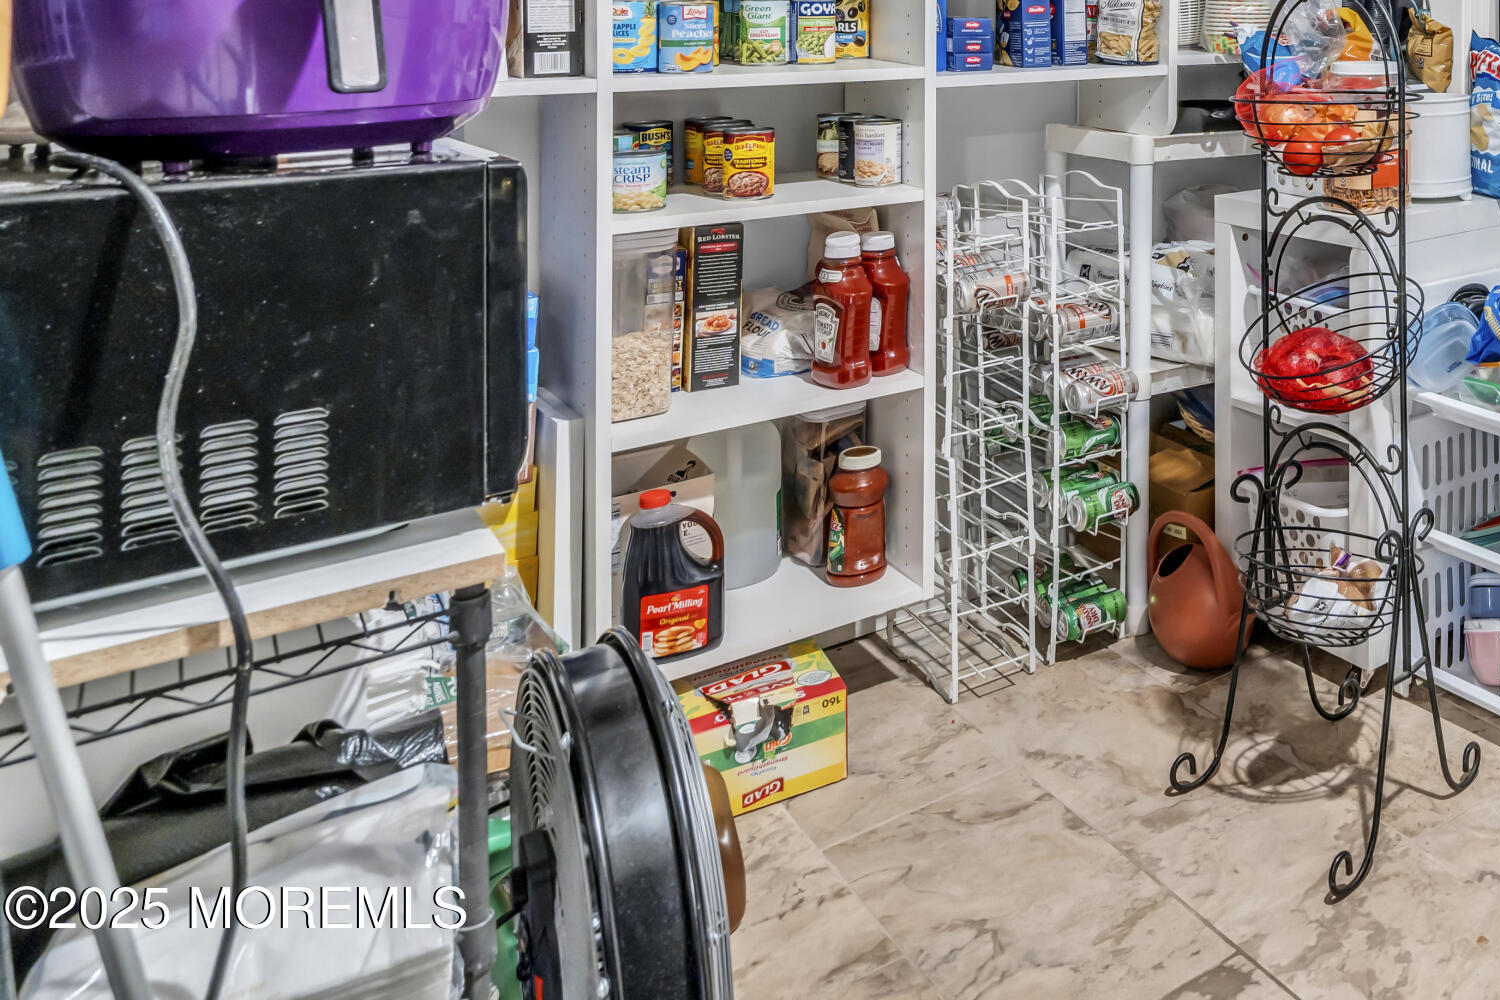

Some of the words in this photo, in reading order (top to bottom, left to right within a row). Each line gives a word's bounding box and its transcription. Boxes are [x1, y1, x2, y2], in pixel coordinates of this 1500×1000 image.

[685, 7, 706, 17] Libby's
[744, 4, 772, 13] Green
[800, 2, 836, 16] GOYA
[746, 12, 772, 21] Giant
[683, 21, 707, 30] Sliced
[1476, 91, 1494, 103] Size!
[641, 130, 671, 143] BUSH'S
[733, 157, 767, 165] TRADITIONAL
[613, 165, 651, 175] steam
[614, 174, 651, 184] CRISP
[697, 235, 712, 243] RED
[711, 233, 741, 242] LOBSTER
[818, 309, 832, 319] HEINZ
[749, 311, 780, 332] BREAD
[816, 319, 833, 332] TOMATO
[646, 601, 672, 616] Pearl
[670, 597, 704, 611] Milling
[659, 613, 690, 627] Original
[708, 663, 784, 693] GLAD
[821, 695, 841, 709] 160
[743, 780, 782, 805] GLAD
